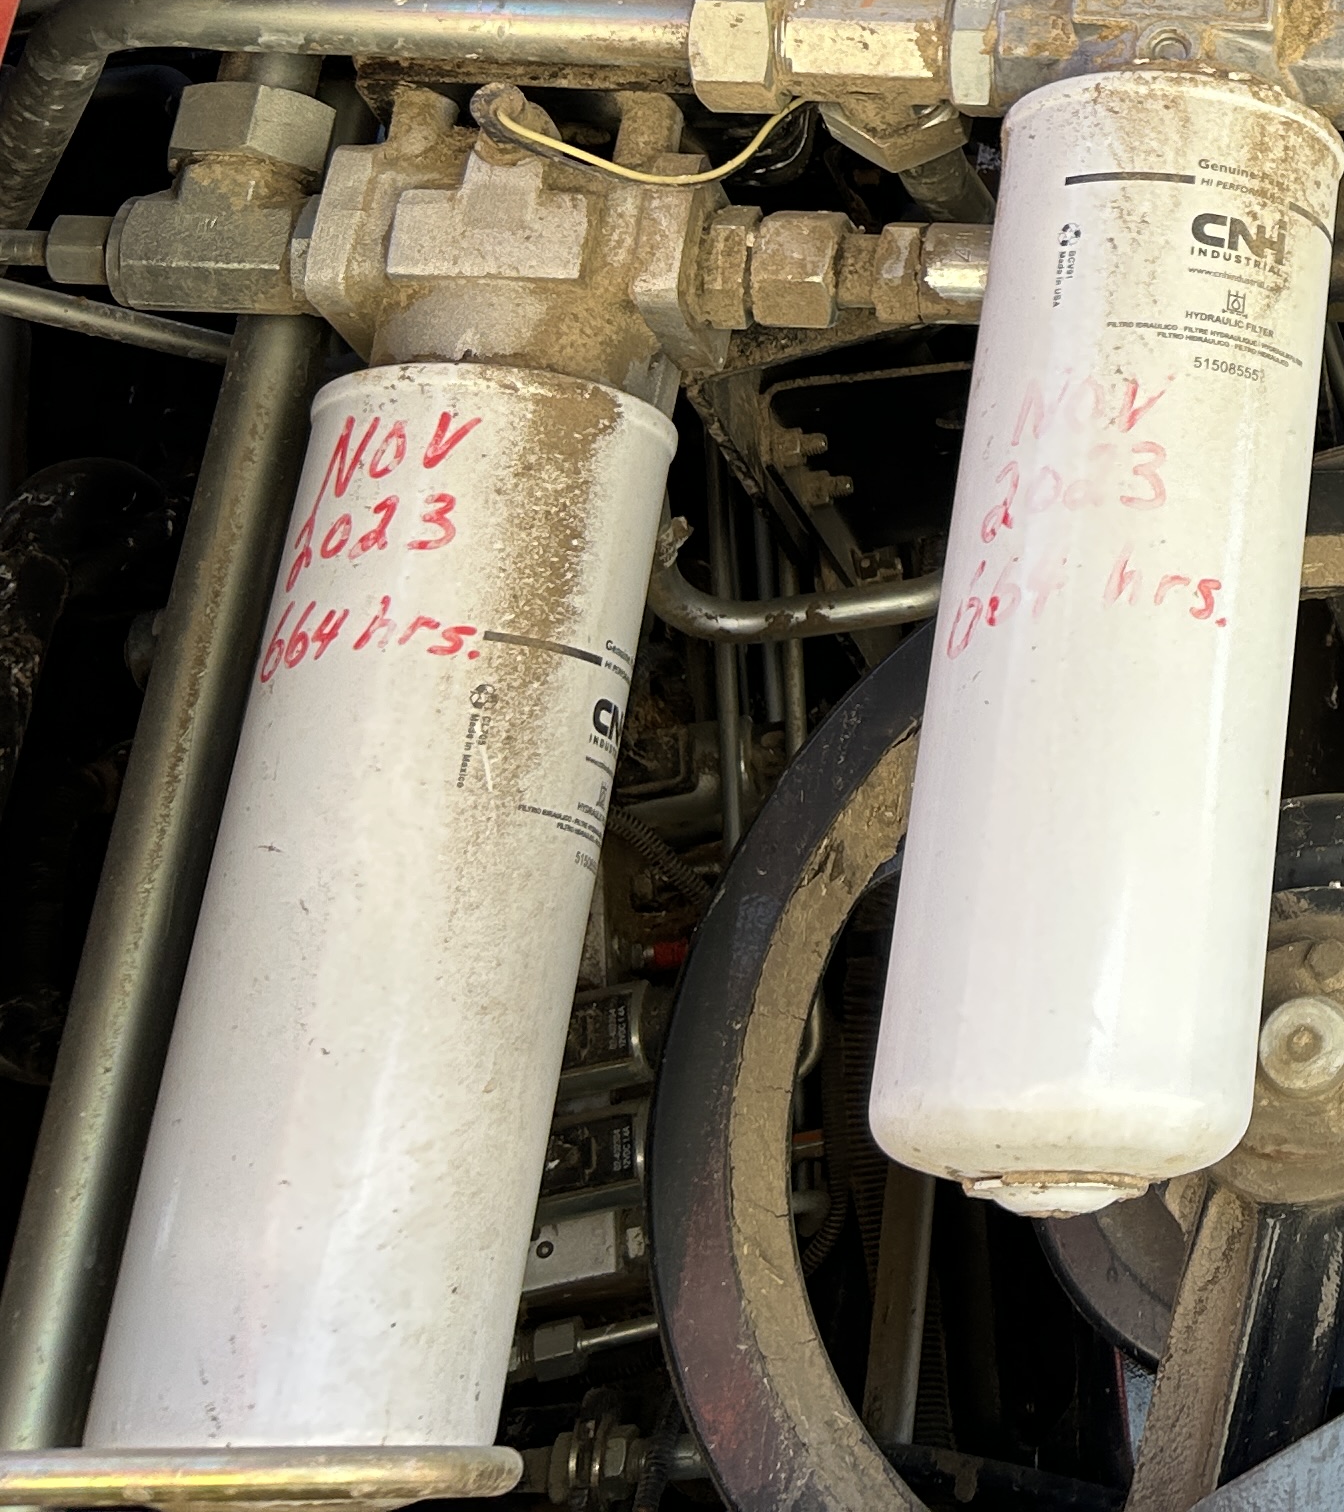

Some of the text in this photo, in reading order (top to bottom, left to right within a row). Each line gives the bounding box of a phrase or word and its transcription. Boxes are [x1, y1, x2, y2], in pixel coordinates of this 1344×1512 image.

[1190, 245, 1283, 278] INDUSTRIAL
[1185, 310, 1275, 339] HYDRAULIC FILTER
[325, 410, 483, 499] NOV
[285, 492, 457, 594] 2023
[260, 594, 481, 683] 664 hrs.
[465, 714, 481, 740] Made
[456, 754, 472, 789] Mexico
